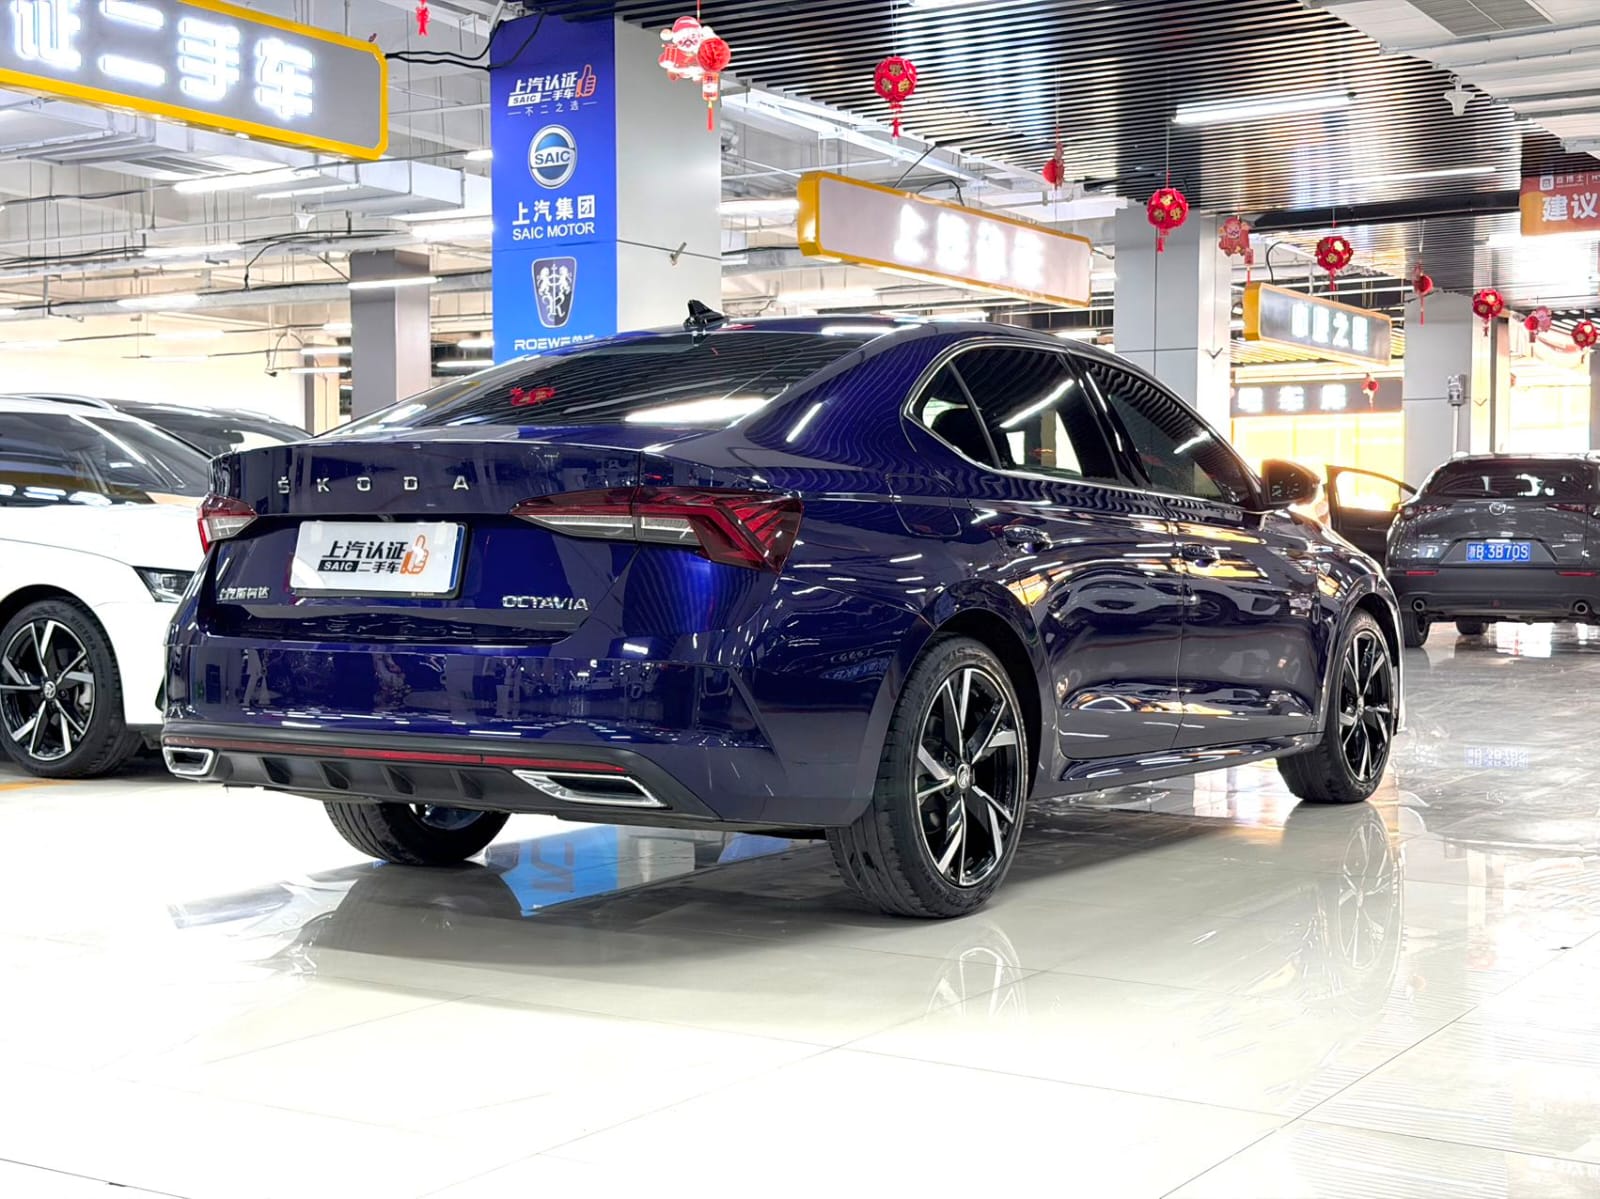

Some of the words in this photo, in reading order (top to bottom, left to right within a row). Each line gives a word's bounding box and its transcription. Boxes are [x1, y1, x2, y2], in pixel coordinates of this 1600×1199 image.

[509, 71, 579, 96] 上汽认证
[512, 94, 538, 105] SAIC
[541, 88, 576, 102] 二手车
[534, 150, 571, 166] SAIC
[512, 194, 596, 226] 上汽集团
[1541, 191, 1598, 222] 建议
[512, 226, 545, 241] SAIC
[546, 221, 596, 238] MOTOR
[277, 475, 470, 494] ŠKODA
[321, 540, 409, 560] 上汽认证
[323, 561, 354, 572] SAIC
[358, 560, 400, 574] 二手车
[501, 594, 589, 611] OCTAVIA
